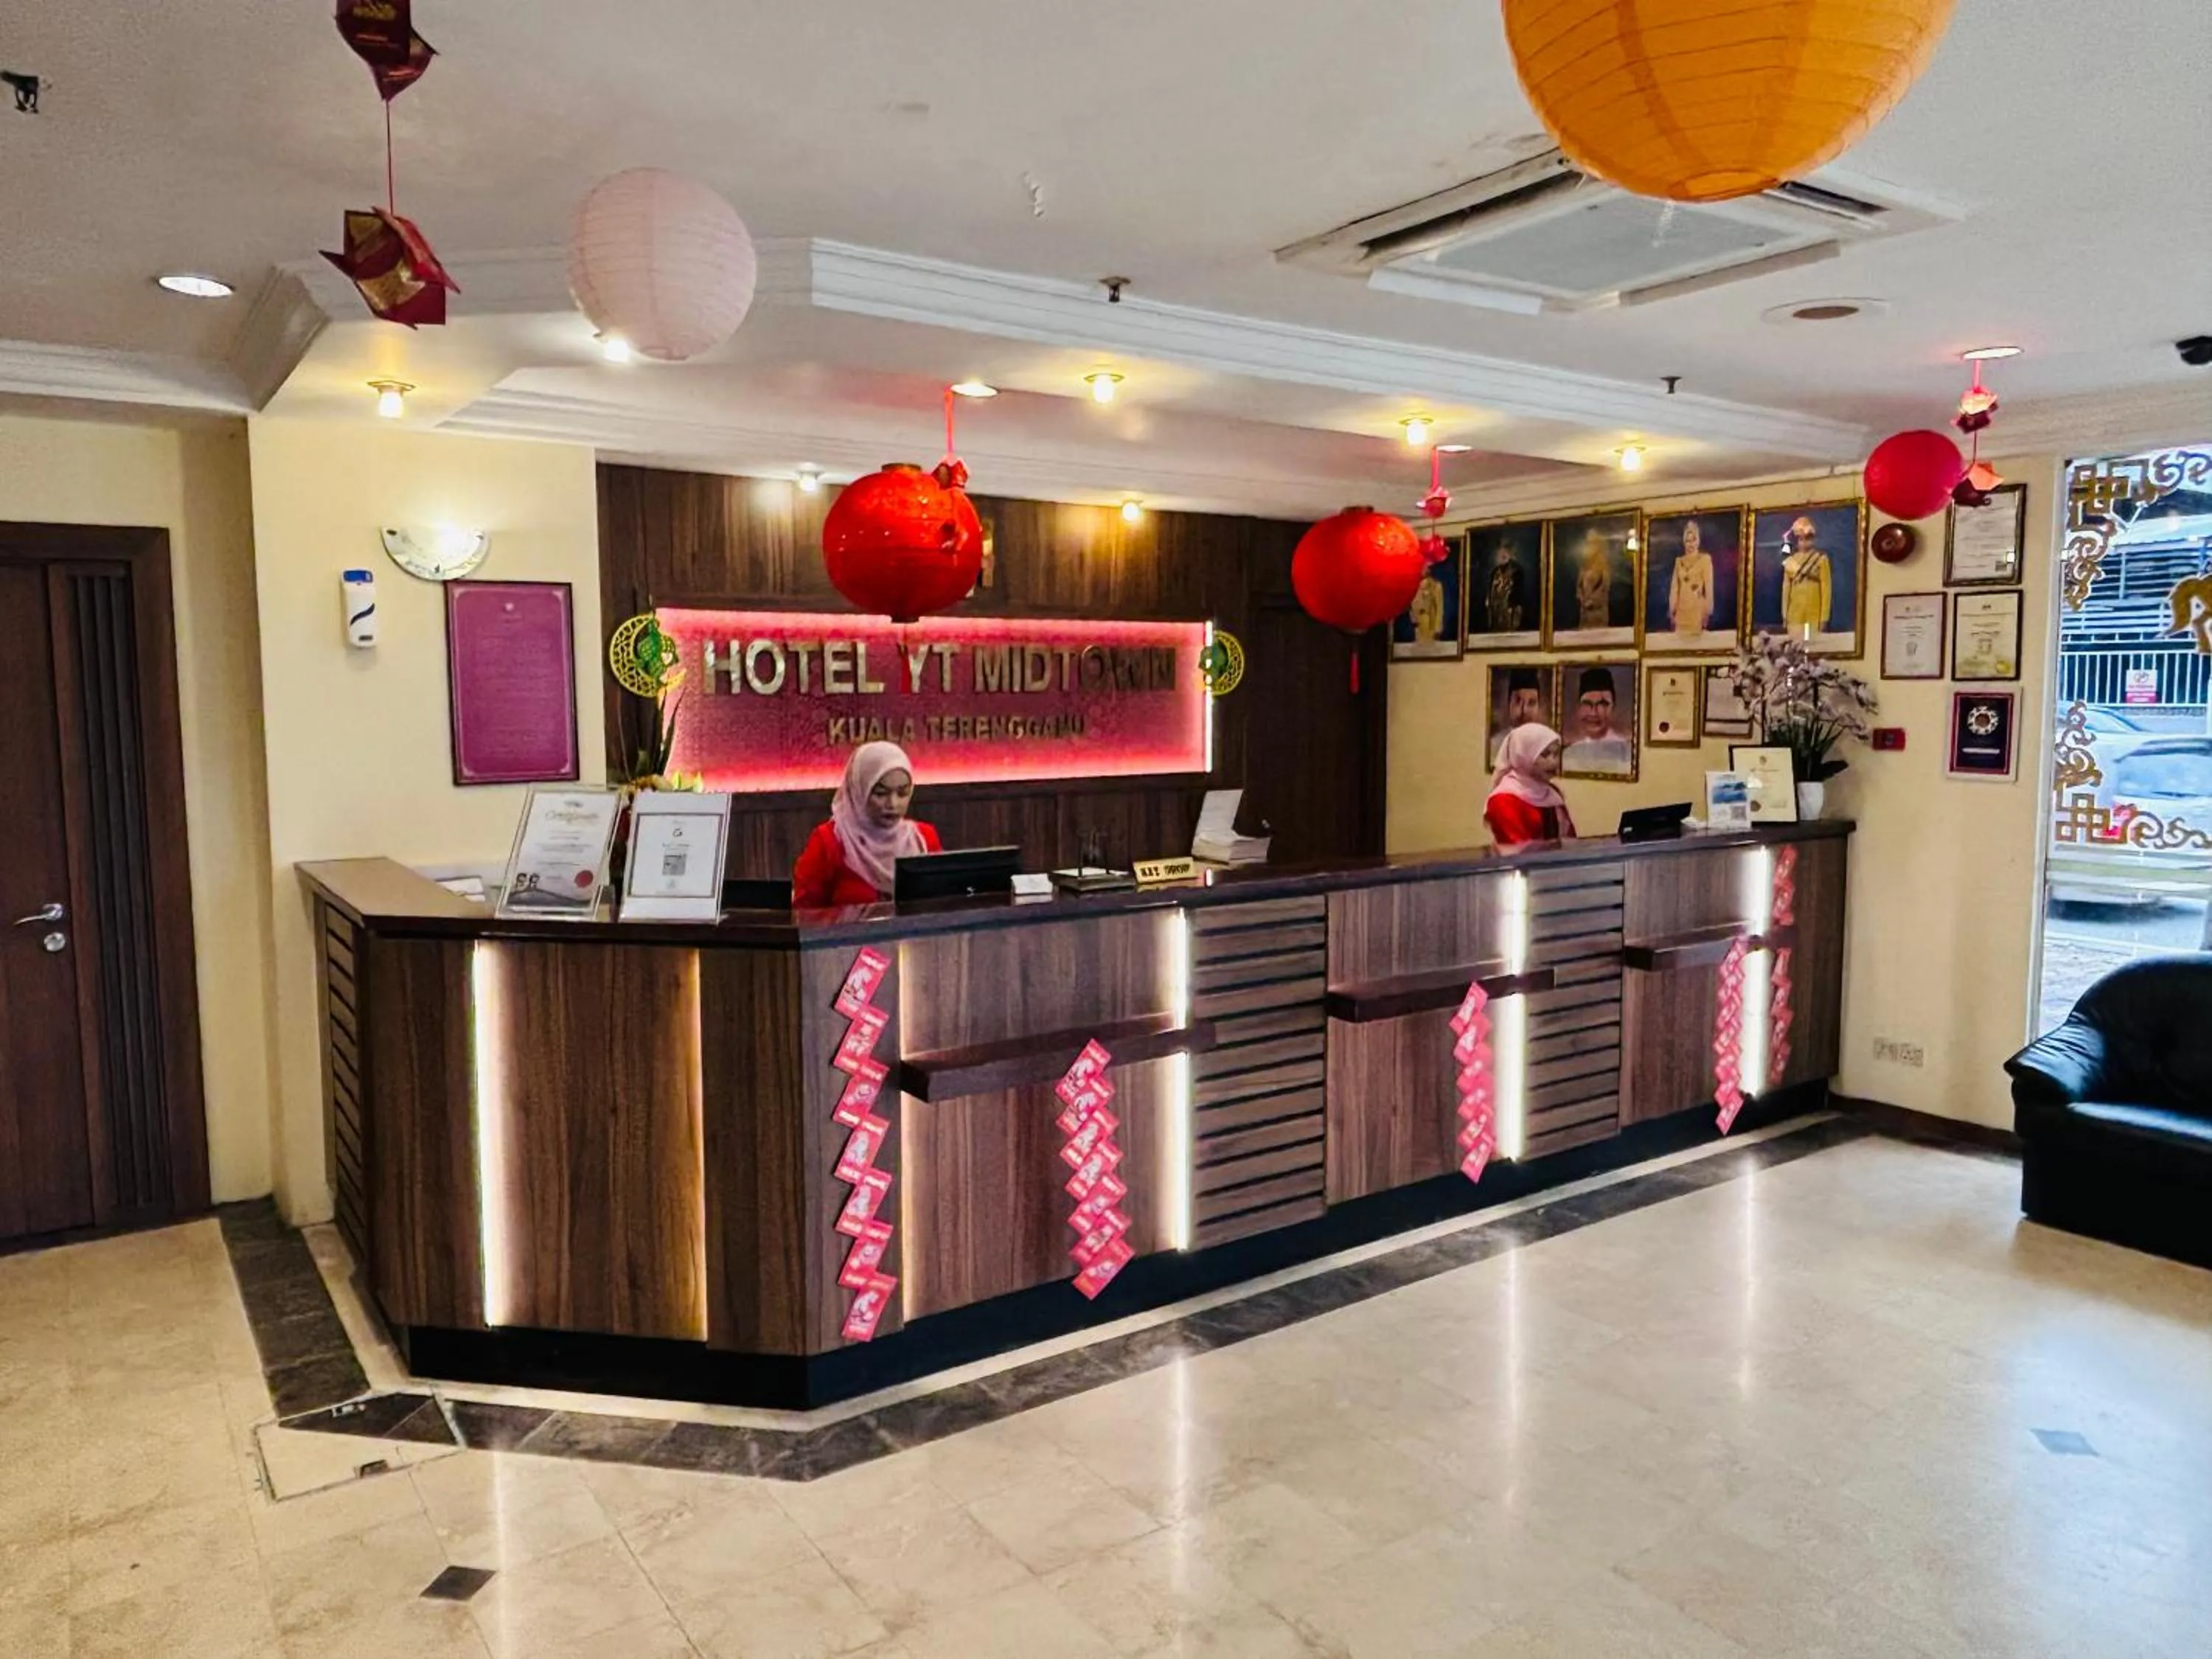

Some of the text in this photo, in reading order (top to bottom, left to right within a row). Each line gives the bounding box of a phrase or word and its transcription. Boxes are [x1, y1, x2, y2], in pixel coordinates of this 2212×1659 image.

[703, 639, 885, 694] HOTEL
[972, 643, 1177, 692] MIDTOWN
[828, 714, 1086, 743] KUALA TERENGGANU
